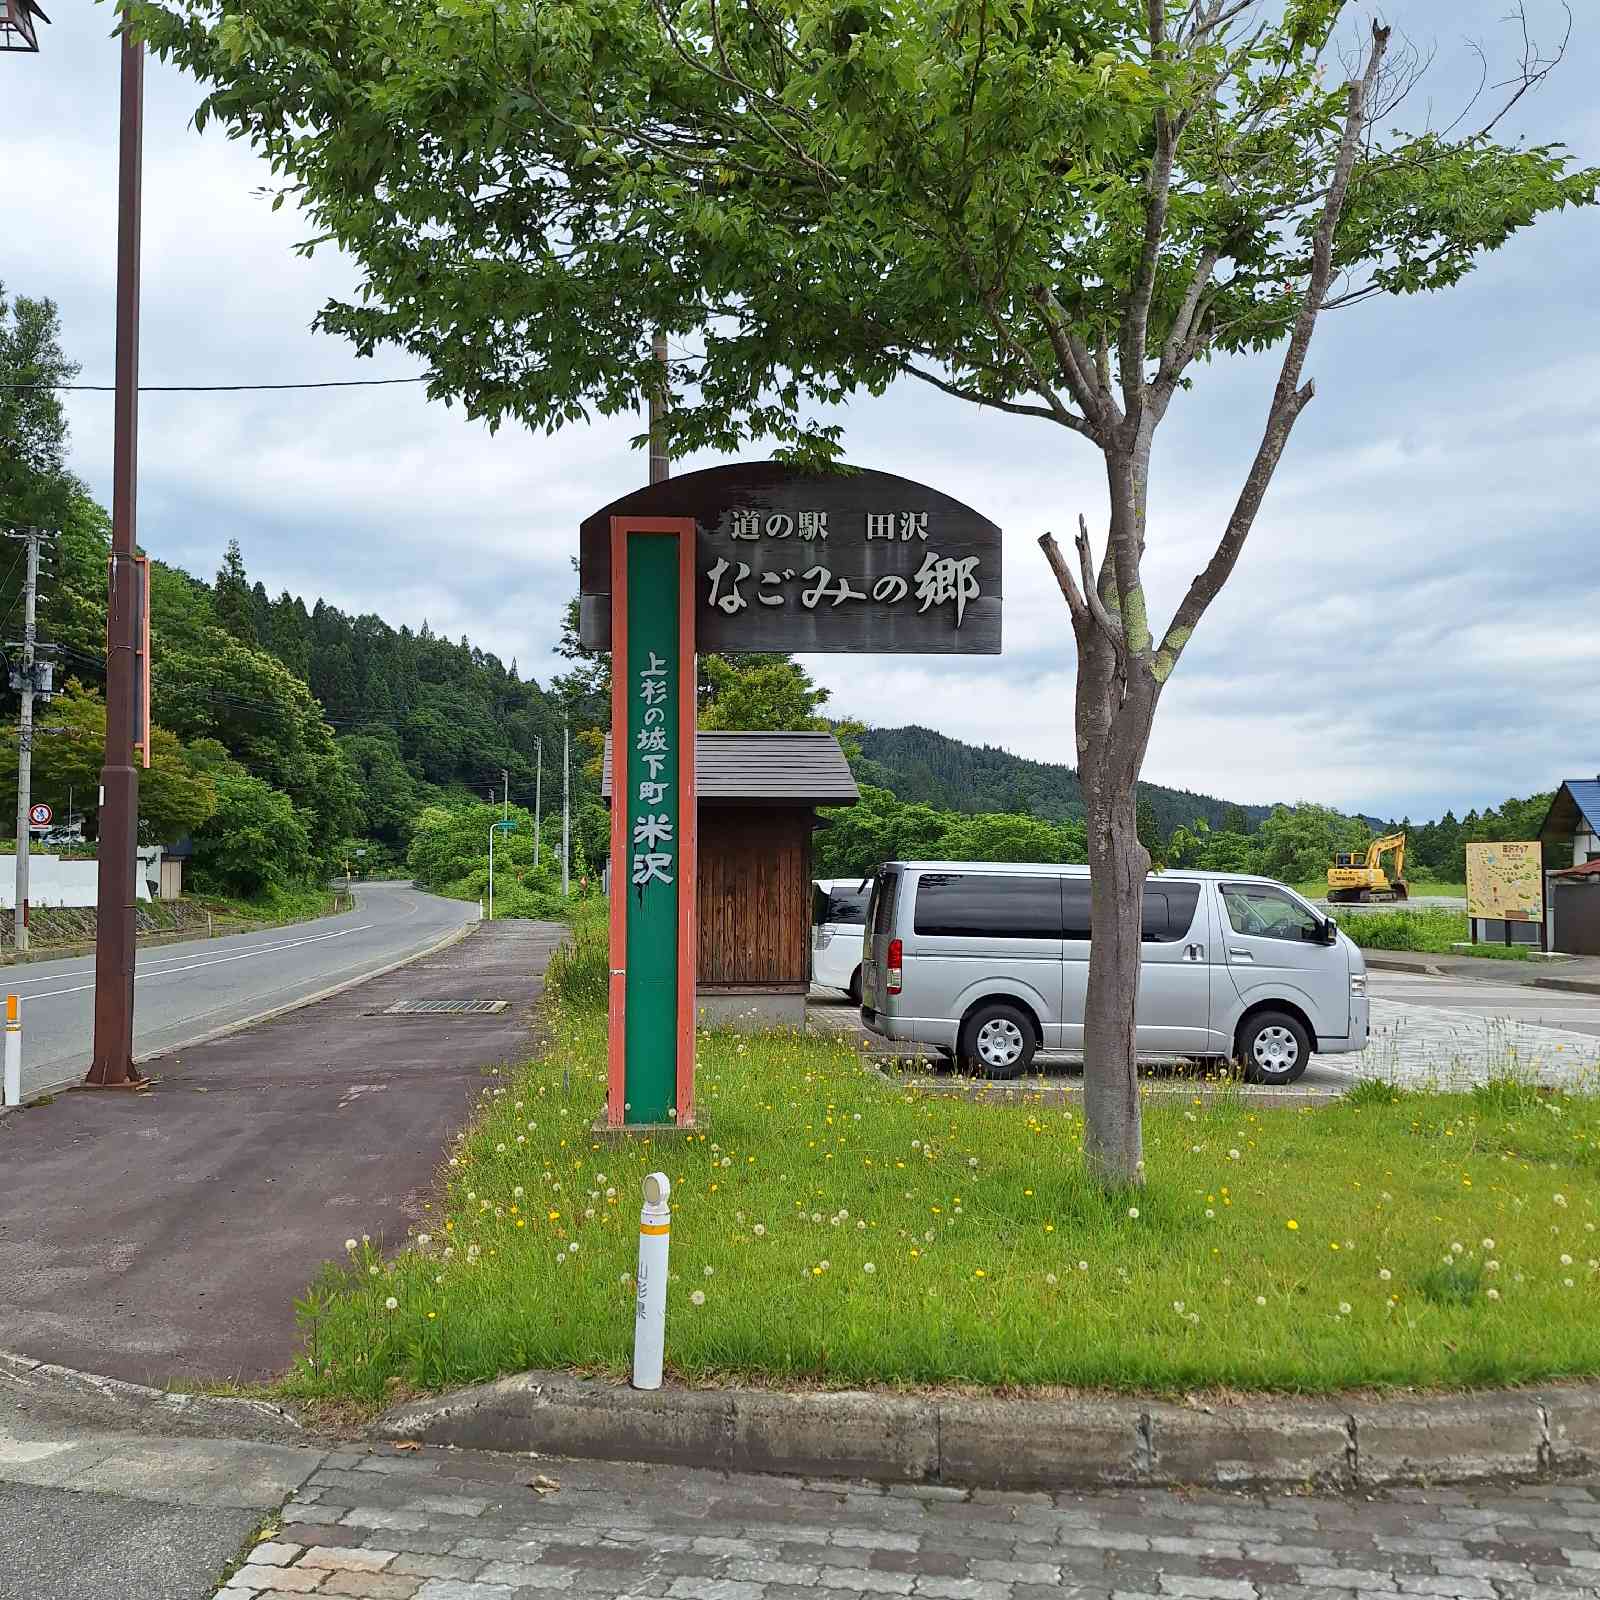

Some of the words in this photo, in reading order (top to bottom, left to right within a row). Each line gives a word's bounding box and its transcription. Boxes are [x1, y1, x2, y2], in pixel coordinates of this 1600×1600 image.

[730, 511, 829, 541] 道の駅
[867, 511, 929, 541] 田沢
[706, 551, 981, 628] なごみの郷
[635, 651, 670, 806] 上杉の城下町
[632, 814, 675, 886] 米沢
